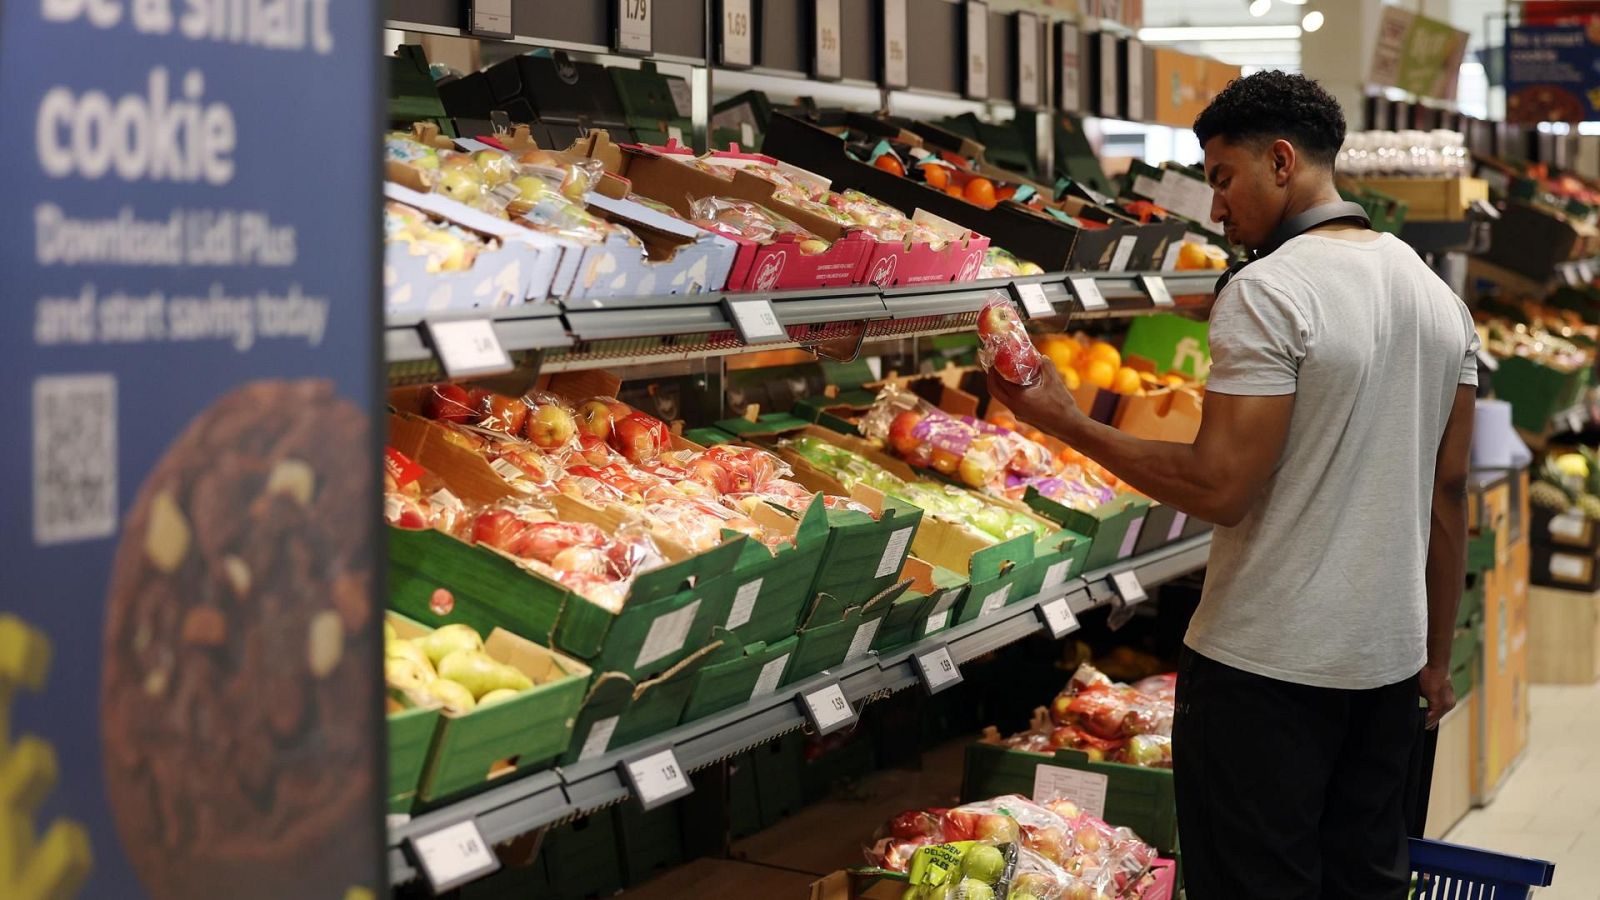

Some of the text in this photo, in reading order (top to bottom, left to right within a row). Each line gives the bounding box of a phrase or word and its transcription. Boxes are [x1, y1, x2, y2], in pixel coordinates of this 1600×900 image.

[625, 0, 647, 21] 1.79
[727, 12, 748, 37] 1.69
[37, 66, 236, 184] cookie
[35, 203, 297, 266] Download Lidl Plus
[35, 283, 329, 351] and start saving today
[937, 844, 961, 855] OLDEN
[929, 857, 949, 871] PLES
